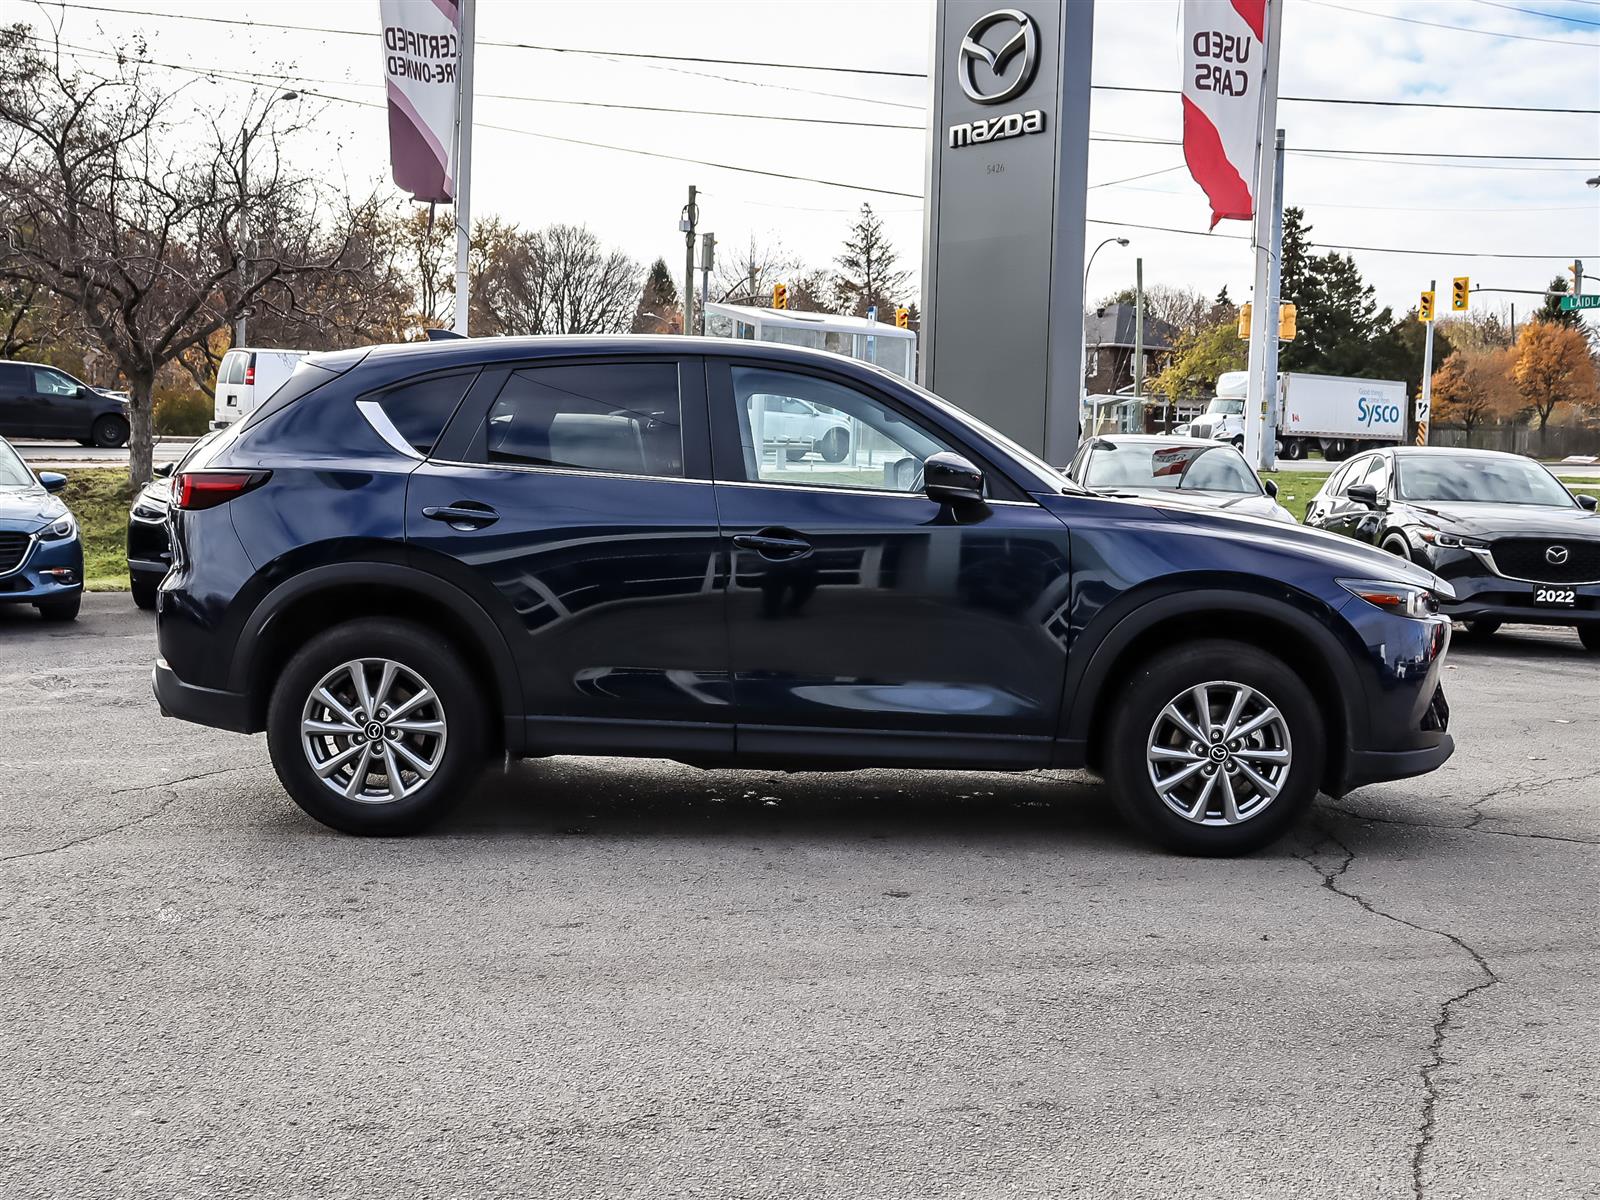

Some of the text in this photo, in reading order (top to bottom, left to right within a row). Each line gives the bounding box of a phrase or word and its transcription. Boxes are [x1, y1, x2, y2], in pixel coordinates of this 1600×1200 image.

[949, 109, 1046, 148] mazda
[1358, 397, 1399, 428] Sysco
[1536, 589, 1575, 603] 2022
